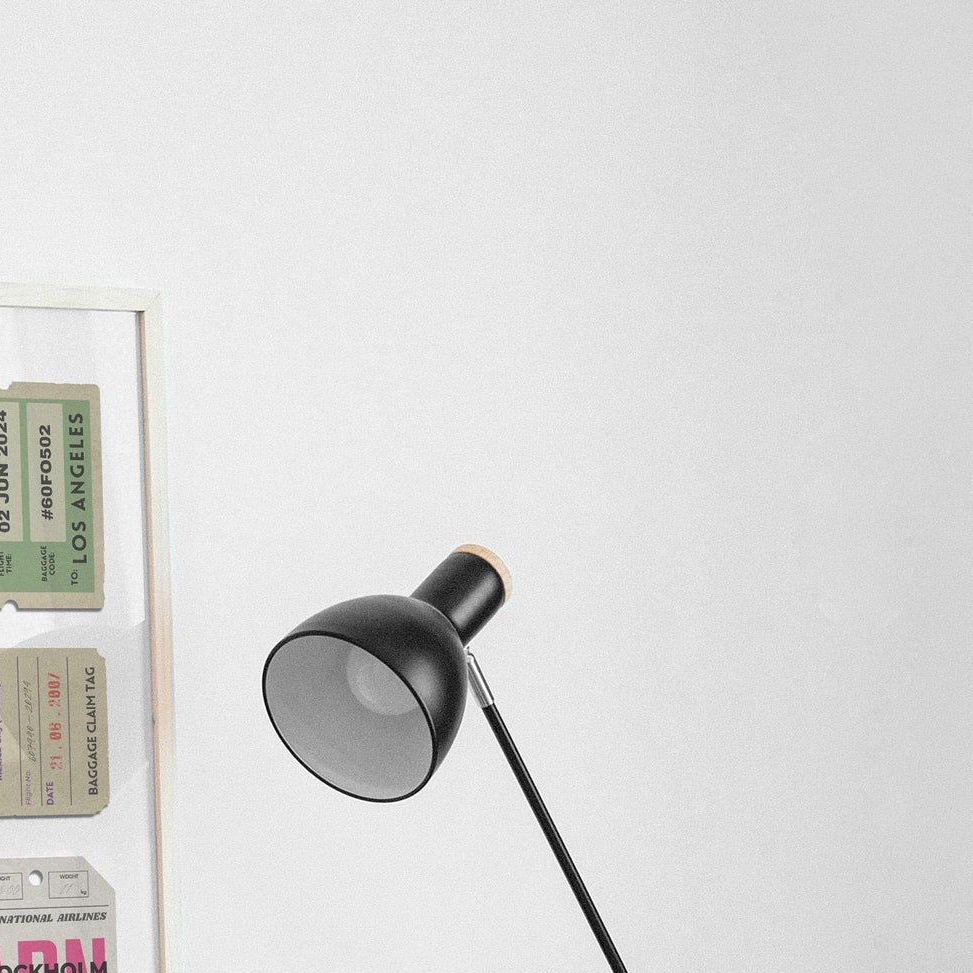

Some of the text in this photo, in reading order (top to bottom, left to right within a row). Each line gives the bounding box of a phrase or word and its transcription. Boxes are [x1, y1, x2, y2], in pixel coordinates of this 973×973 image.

[69, 413, 87, 585] TO: LOS ANGELES
[85, 667, 98, 795] BAGGAGE CLAIM TAG
[57, 912, 107, 922] AIRLINES
